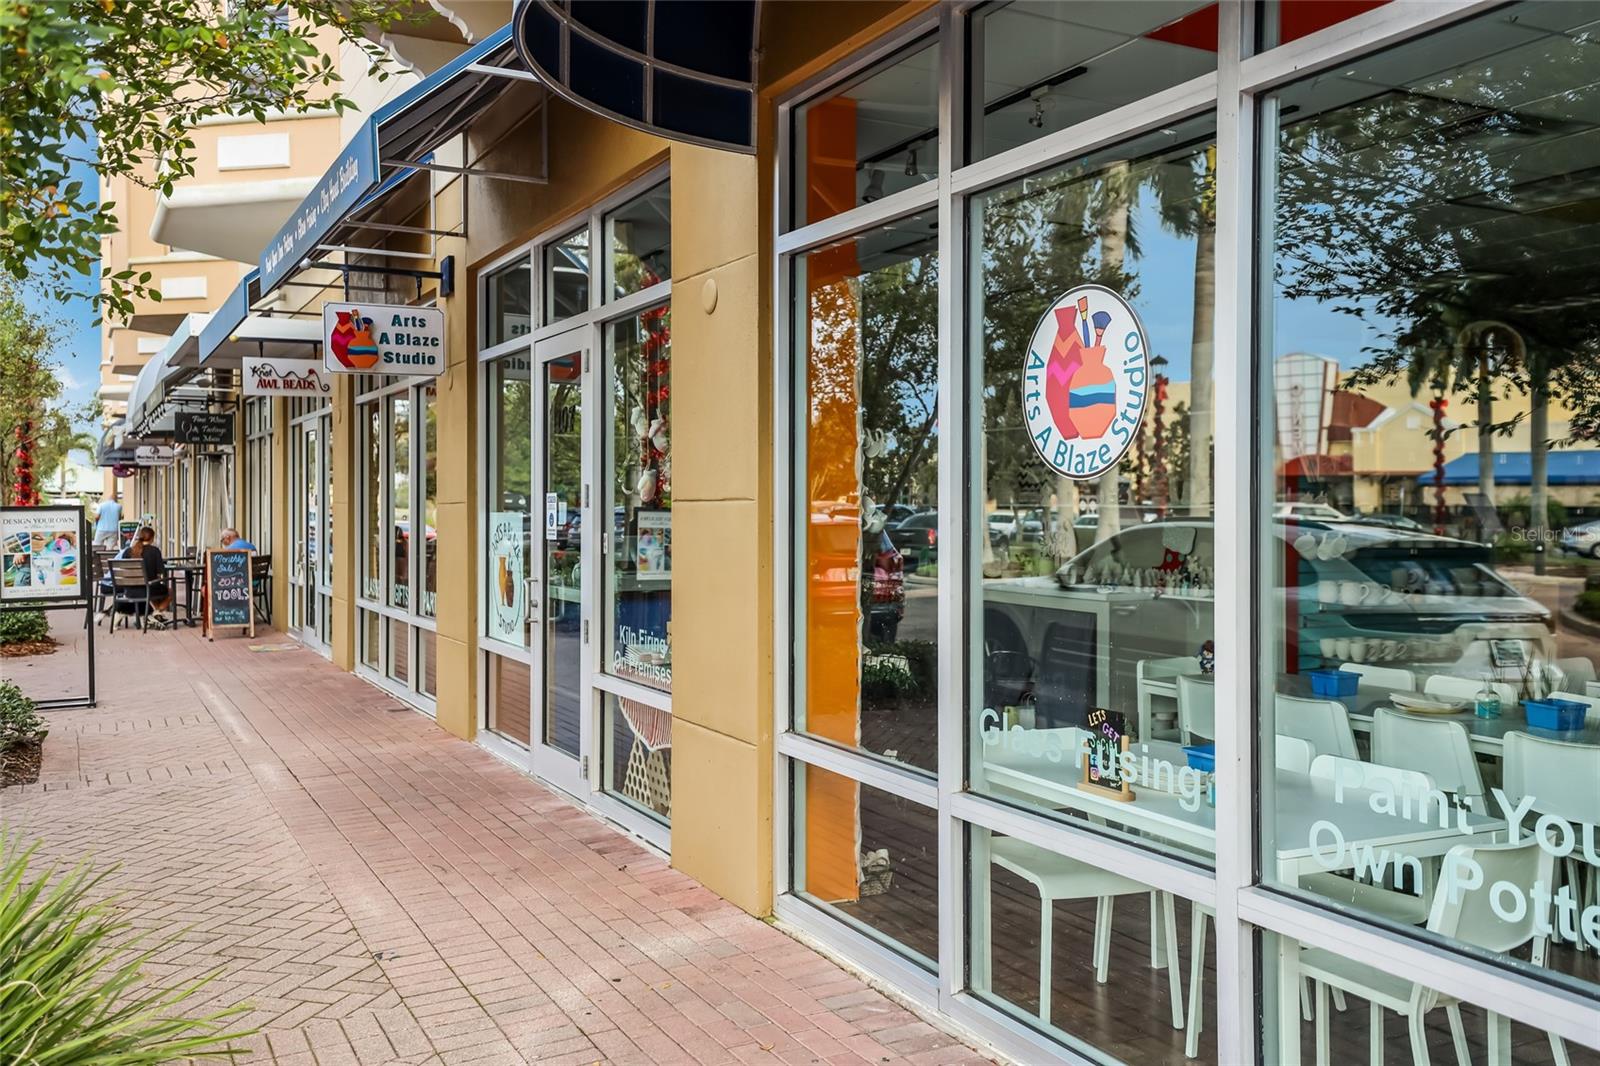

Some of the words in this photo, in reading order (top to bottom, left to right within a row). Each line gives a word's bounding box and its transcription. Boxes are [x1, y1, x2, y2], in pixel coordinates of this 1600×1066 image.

[391, 314, 427, 328] Arts
[379, 332, 391, 345] A
[394, 332, 440, 347] Blaze
[383, 351, 436, 365] Studio
[250, 365, 273, 379] Knot
[256, 378, 279, 390] AWL
[283, 379, 317, 390] BEADS
[1026, 349, 1045, 421] Arts
[1111, 331, 1145, 446] Studio
[1035, 425, 1053, 452] A
[1053, 439, 1113, 474] Blaze
[214, 554, 246, 567] Monthly
[216, 564, 236, 573] Sale
[215, 588, 249, 600] TOOLS
[619, 624, 637, 645] Kiln
[638, 629, 667, 658] Firing
[613, 650, 626, 674] On
[628, 657, 671, 682] Premises
[1088, 709, 1107, 726] LETS
[1102, 722, 1120, 742] GET
[979, 708, 1062, 763] Glass
[1075, 728, 1202, 813] Fusing
[1334, 756, 1474, 835] Paint
[1308, 820, 1424, 897] Own
[1450, 853, 1600, 955] Potte
